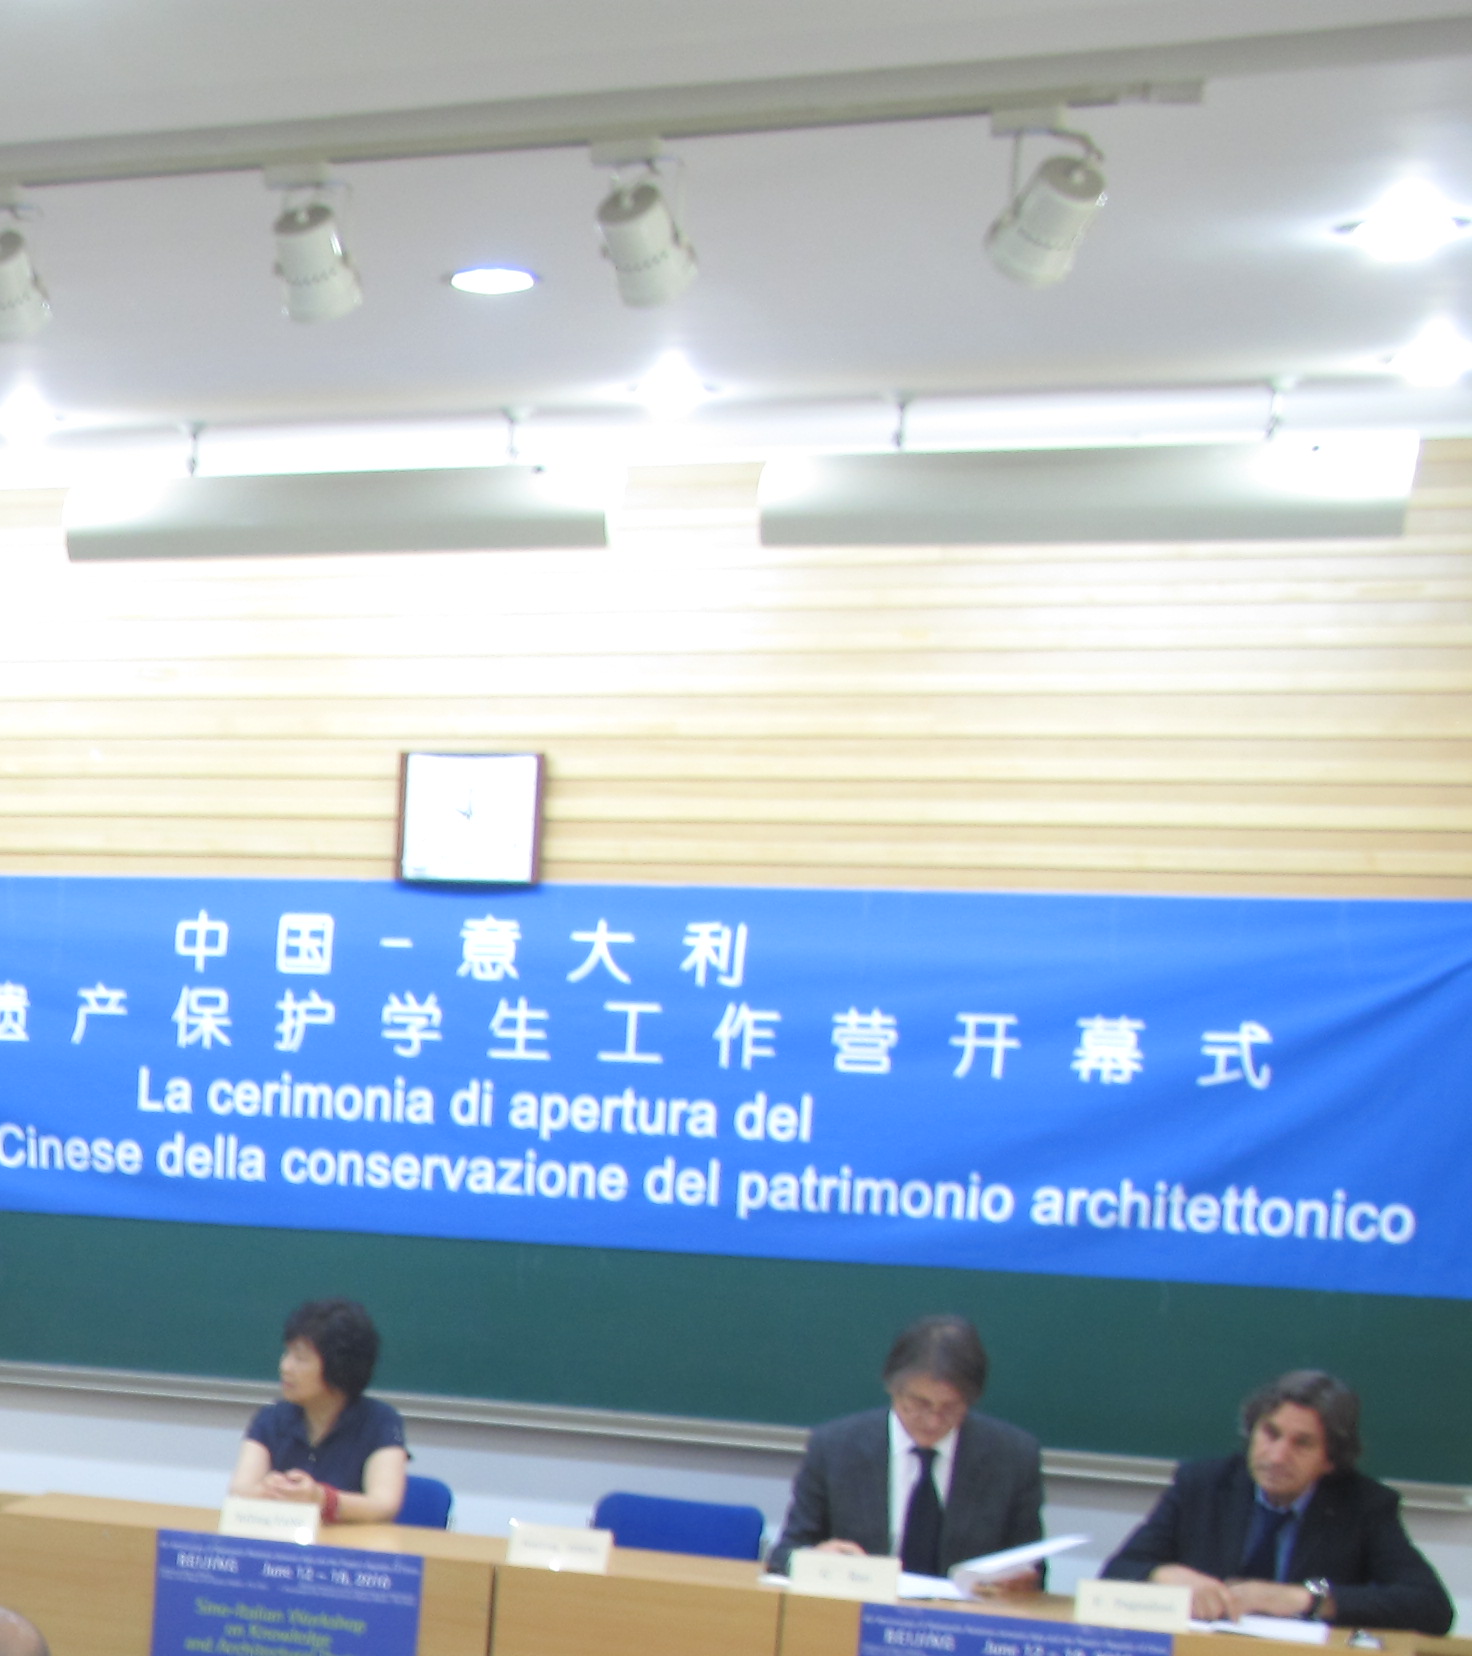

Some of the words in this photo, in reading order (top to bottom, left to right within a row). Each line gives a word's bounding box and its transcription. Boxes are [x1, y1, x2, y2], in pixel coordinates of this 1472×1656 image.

[137, 1065, 192, 1113] La
[208, 1071, 434, 1124] cerimonia
[450, 1078, 494, 1126] di
[509, 1086, 718, 1139] apertura
[735, 1091, 813, 1142] del
[157, 1132, 267, 1182] della
[280, 1147, 629, 1202] conservazione
[644, 1157, 721, 1207] del
[737, 1165, 1016, 1223] patrimonio
[1031, 1178, 1417, 1245] architettonico
[176, 1551, 239, 1574] BEIJING
[262, 1562, 292, 1580] June
[195, 1597, 284, 1623] Sino-Italian
[288, 1608, 367, 1635] Workshop
[224, 1623, 244, 1636] on
[184, 1636, 213, 1653] and
[883, 1626, 955, 1651] BEIJING
